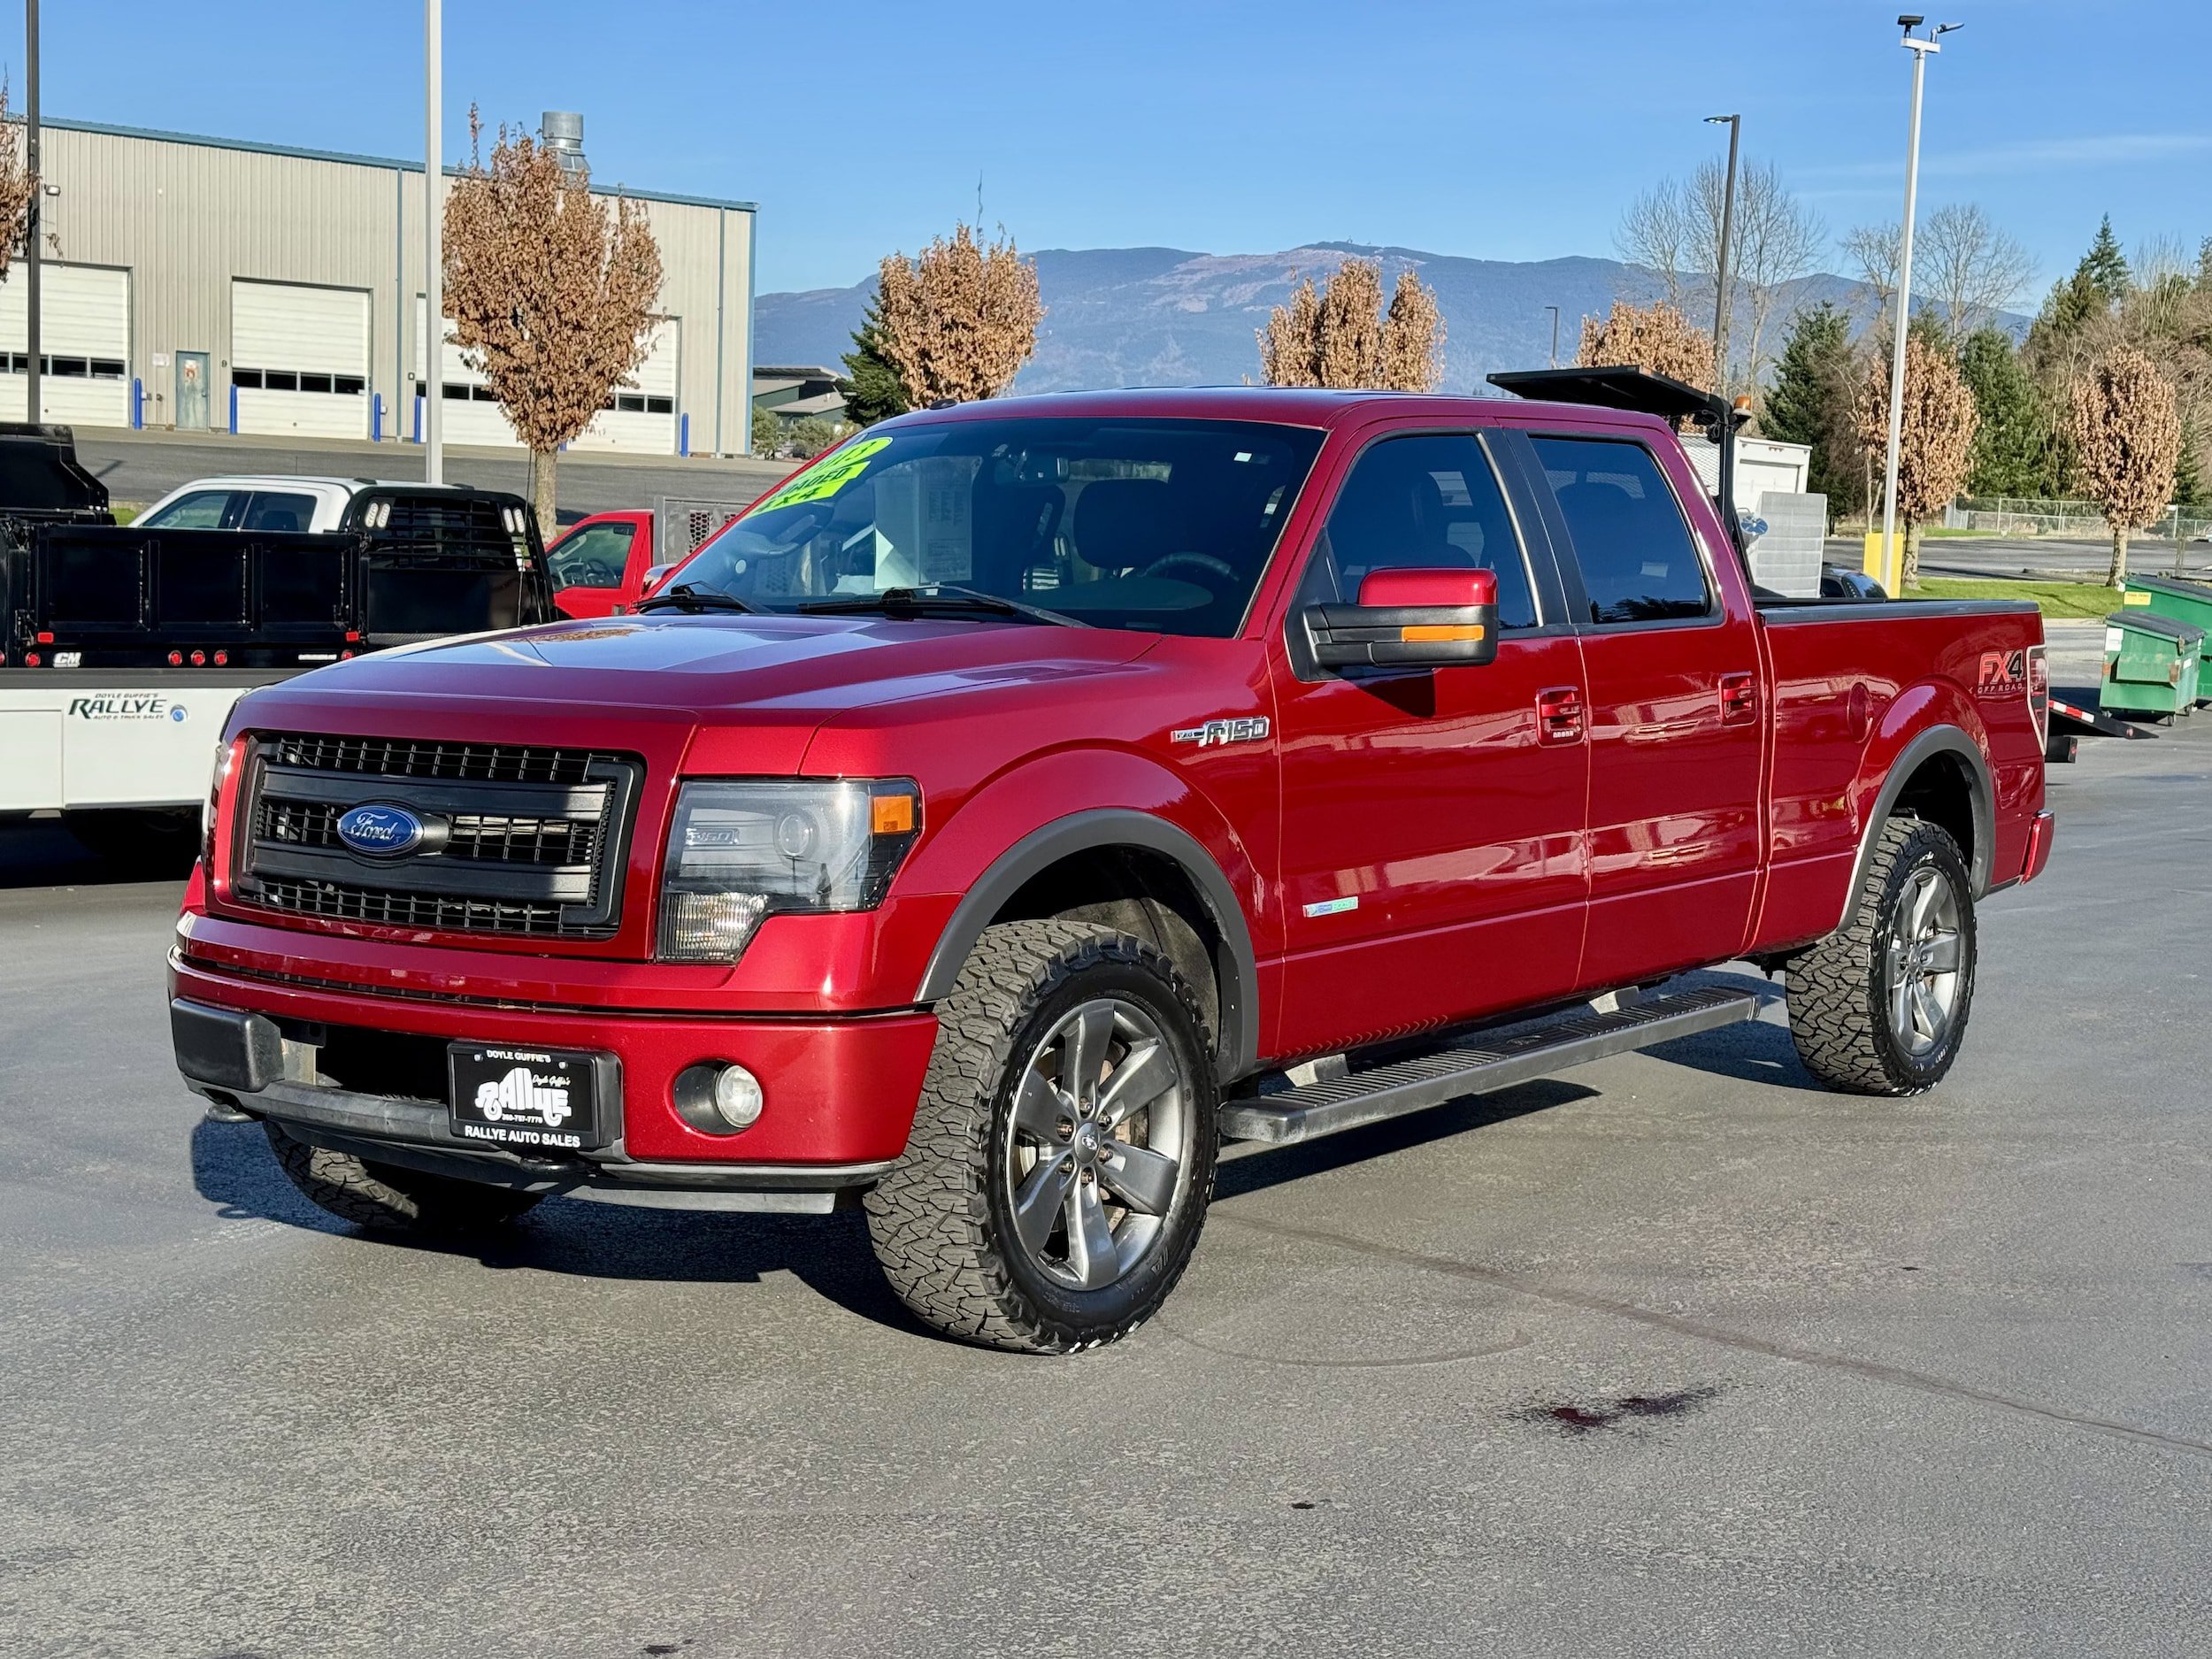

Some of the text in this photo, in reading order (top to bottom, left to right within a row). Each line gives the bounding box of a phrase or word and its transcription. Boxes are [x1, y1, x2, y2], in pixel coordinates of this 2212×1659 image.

[54, 652, 81, 664] CM
[1978, 649, 2024, 686] FX4
[68, 698, 167, 719] RALLYE
[350, 811, 399, 841] Ford
[487, 1049, 551, 1063] DOYLE GUFFIE'S
[465, 1125, 581, 1148] RALLYE AUTO SALES
